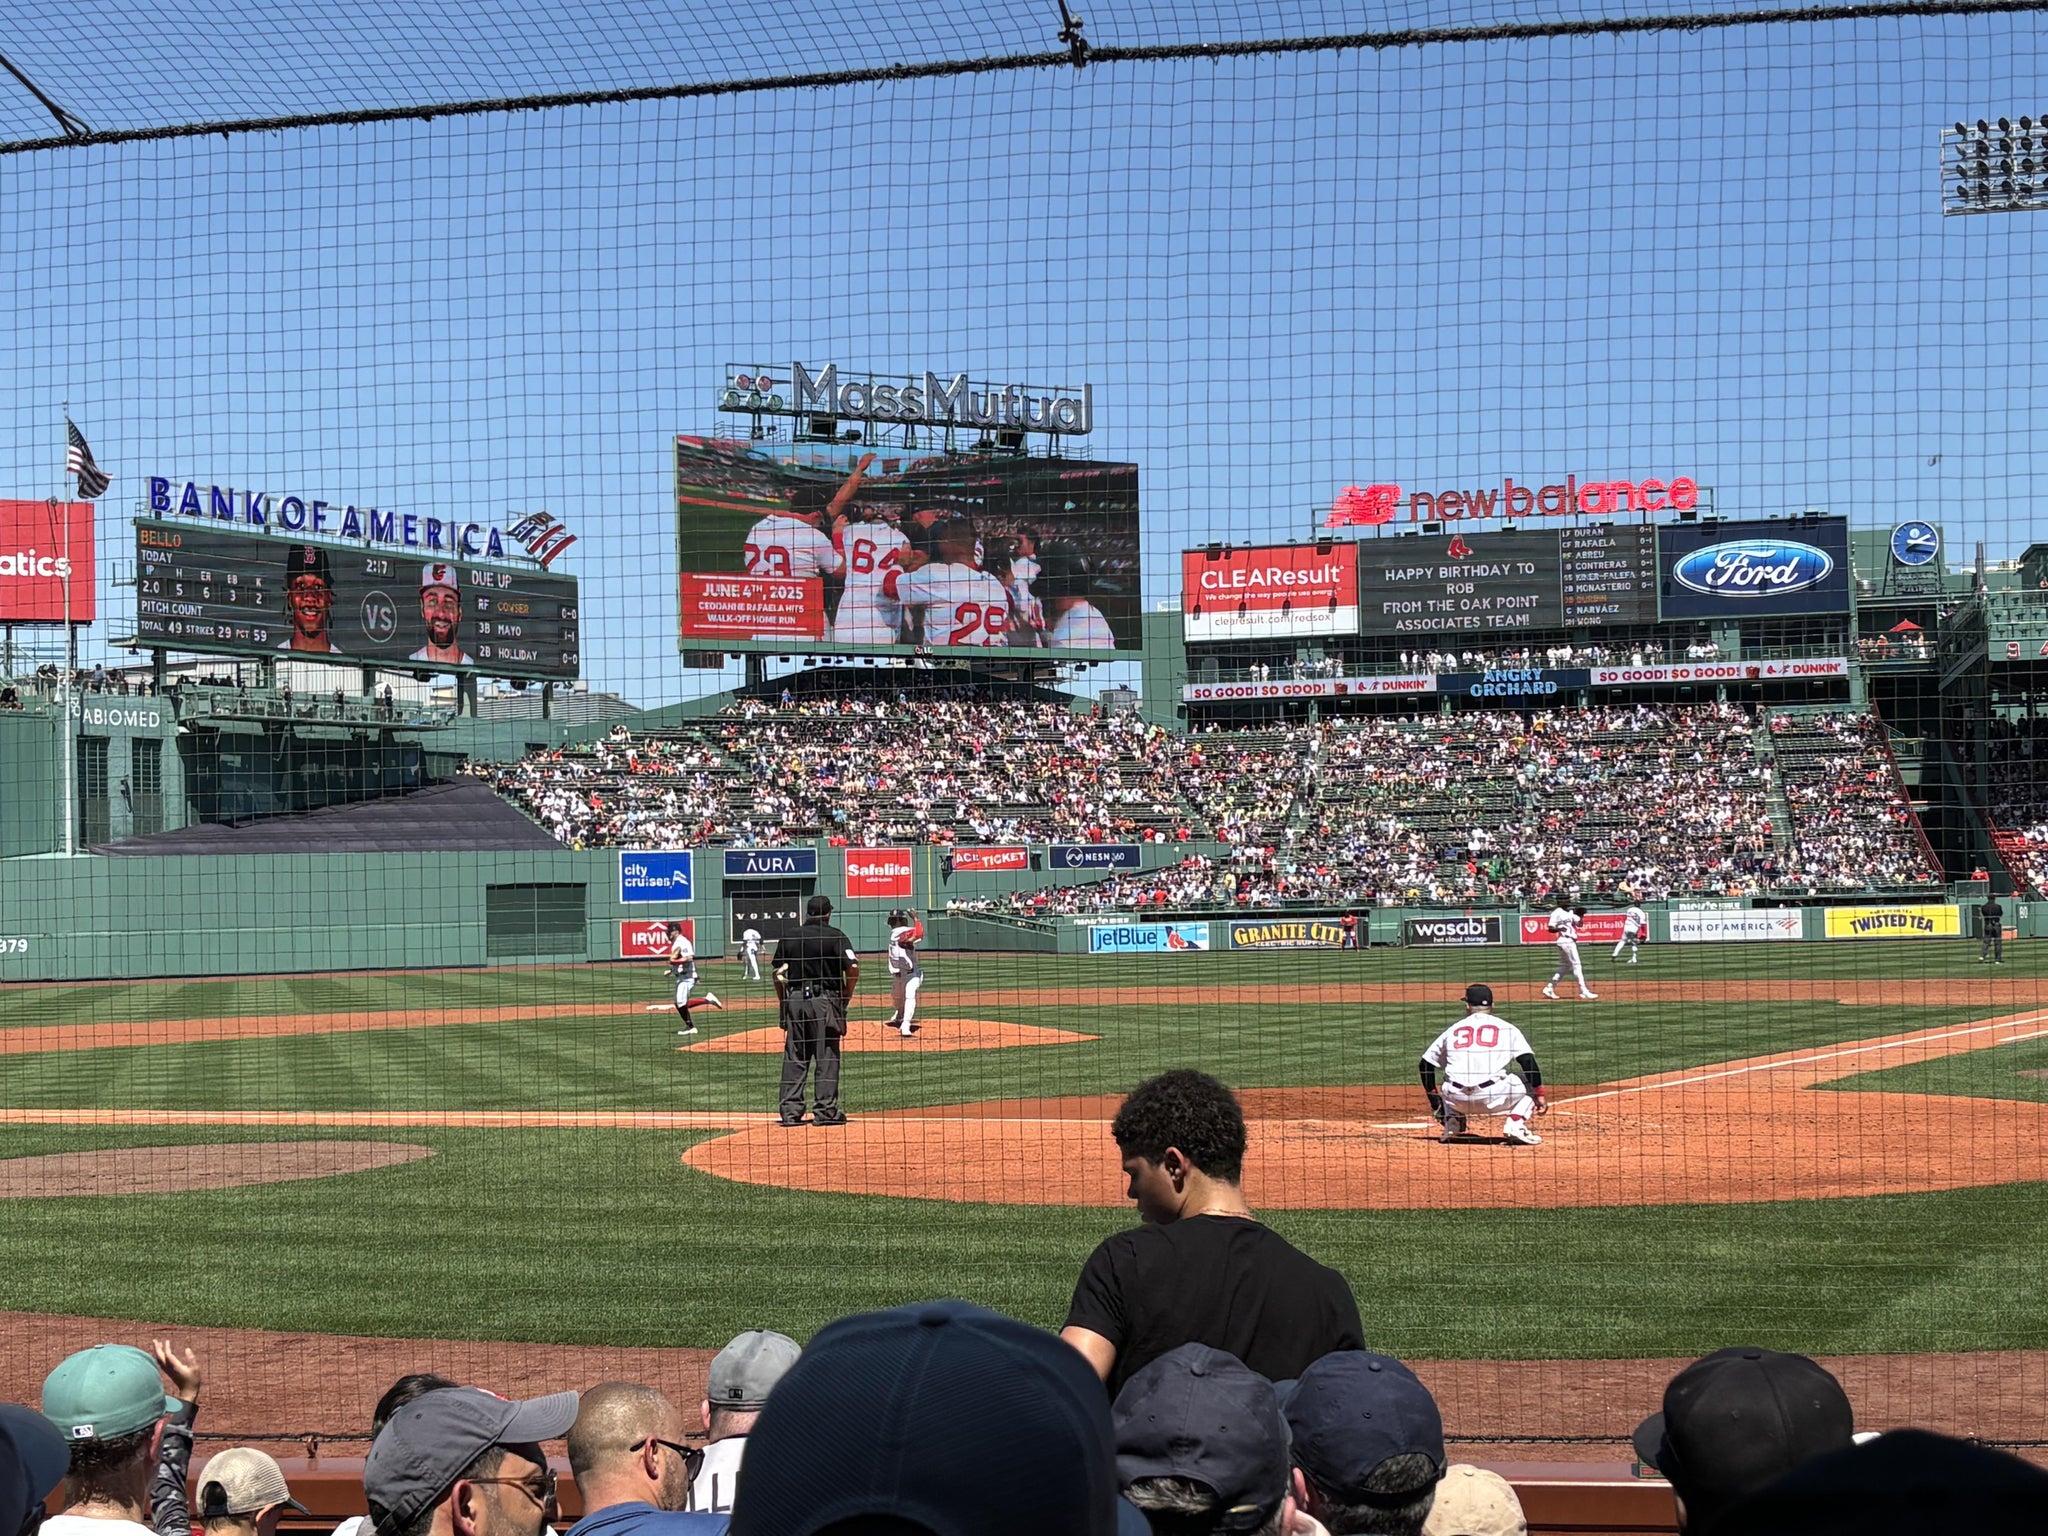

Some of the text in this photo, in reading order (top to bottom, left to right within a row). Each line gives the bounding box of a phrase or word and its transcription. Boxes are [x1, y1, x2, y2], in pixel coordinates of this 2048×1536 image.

[792, 361, 1092, 435] MassMutual
[147, 476, 504, 558] BANK OF AMERICA
[140, 530, 182, 548] BELLO
[1574, 528, 1604, 536] DURAN
[1574, 539, 1616, 548] RAFAELA
[141, 549, 173, 564] TODAY
[853, 538, 902, 574] 64
[1575, 551, 1605, 559] ABREU
[366, 558, 388, 575] 2:17
[1385, 563, 1535, 581] HAPPY BIRTHDAY TO
[1575, 561, 1627, 570] CONTRERAS
[1705, 549, 1800, 586] Ford
[146, 565, 155, 576] IP
[176, 568, 182, 578] H
[201, 571, 212, 581] ER
[256, 578, 262, 588] K
[471, 570, 512, 589] DUE UP
[1201, 563, 1341, 589] CLEAResult
[142, 580, 262, 605] 2.0 5 6 3 2
[702, 583, 804, 600] JUNE 4TH, 2025
[1446, 583, 1474, 595] ROB
[1576, 582, 1631, 592] MONASTERIO
[1218, 593, 1243, 601] change
[1383, 595, 1539, 614] FROM THE OAK POINT
[141, 600, 203, 616] PITCH COUNT
[478, 598, 490, 611] RF
[561, 608, 577, 620] 0-0
[698, 601, 804, 613] CEDDANNE RAFAELA HITS
[1577, 604, 1620, 614] NARVÁEZ
[365, 604, 393, 631] VS
[707, 613, 796, 625] WALK-OFF HOME RUN
[1395, 614, 1530, 631] ASSOCIATES TEAM!
[1577, 617, 1601, 625] WONG
[141, 621, 268, 642] TOTAL 49 STRIKES 29 PCT 59
[479, 622, 491, 634] 3B
[498, 625, 522, 637] MAYO
[479, 645, 578, 665] 2B HOLLIDAY 0-0
[1483, 668, 1543, 682] ANGRY
[1599, 666, 1740, 682] SO GOOD! SO GOOD!
[1793, 663, 1841, 674] DUNKIN'
[1194, 683, 1326, 699] SO GOOD! SO GOOD!
[1382, 680, 1428, 690] DUNKIN'
[1470, 681, 1557, 697] ORCHARD
[83, 708, 160, 728] ABIOMED
[982, 852, 1026, 868] TICKET
[1085, 853, 1110, 861] NESN
[625, 864, 648, 877] city
[848, 863, 910, 876] Safelite
[625, 877, 670, 888] cruises
[735, 911, 797, 921] VOLVO
[1850, 914, 1933, 934] TWISTED TEA
[1234, 924, 1307, 945] GRANITE
[1415, 917, 1487, 936] wasabi
[1673, 923, 1773, 932] BANK OF AMERICA
[632, 932, 672, 945] IRVIN
[1097, 928, 1157, 950] jetBlue
[1453, 1024, 1499, 1049] 30
